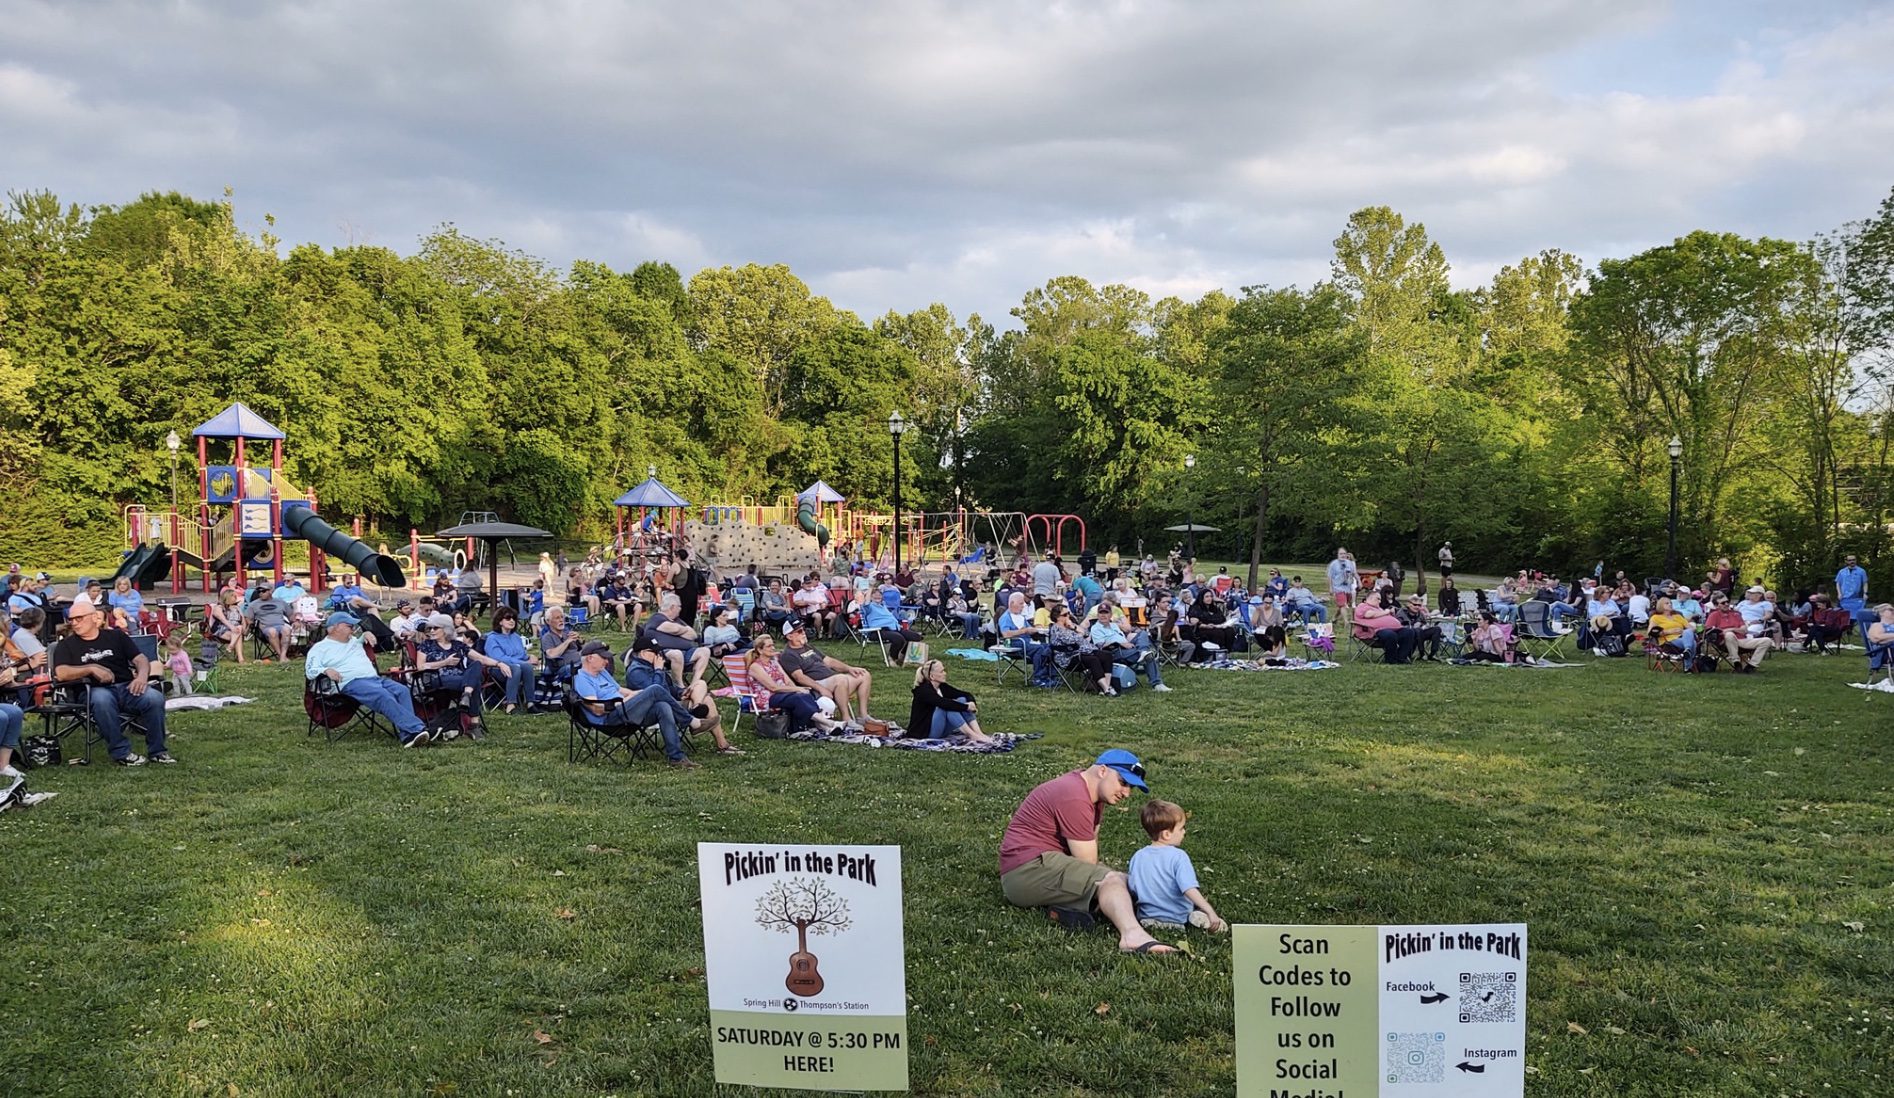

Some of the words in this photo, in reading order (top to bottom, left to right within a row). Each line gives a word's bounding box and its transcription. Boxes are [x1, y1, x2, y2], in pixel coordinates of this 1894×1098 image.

[724, 850, 780, 886] Pickin'
[784, 850, 801, 872] in
[805, 851, 834, 875] the
[837, 853, 877, 887] Park
[1279, 933, 1329, 955] Scan
[1386, 932, 1436, 963] Pickin'
[1440, 931, 1455, 951] in
[1458, 931, 1484, 952] the
[1487, 932, 1521, 961] Park
[1259, 965, 1324, 986] Codes
[1330, 967, 1352, 987] to
[1386, 981, 1436, 992] Facebook
[743, 998, 767, 1009] Spring
[768, 999, 781, 1008] Hill
[800, 1000, 843, 1010] Thompson's
[844, 1001, 870, 1010] Station
[1271, 996, 1341, 1017] Follow
[717, 1026, 804, 1048] SATURDAY
[808, 1031, 823, 1049] @
[827, 1032, 868, 1049] 5:30
[873, 1032, 900, 1049] PM
[1277, 1032, 1302, 1048] us
[1308, 1032, 1335, 1048] on
[784, 1055, 834, 1073] HERE!
[1464, 1048, 1518, 1060] Instagram
[1275, 1058, 1337, 1079] Social
